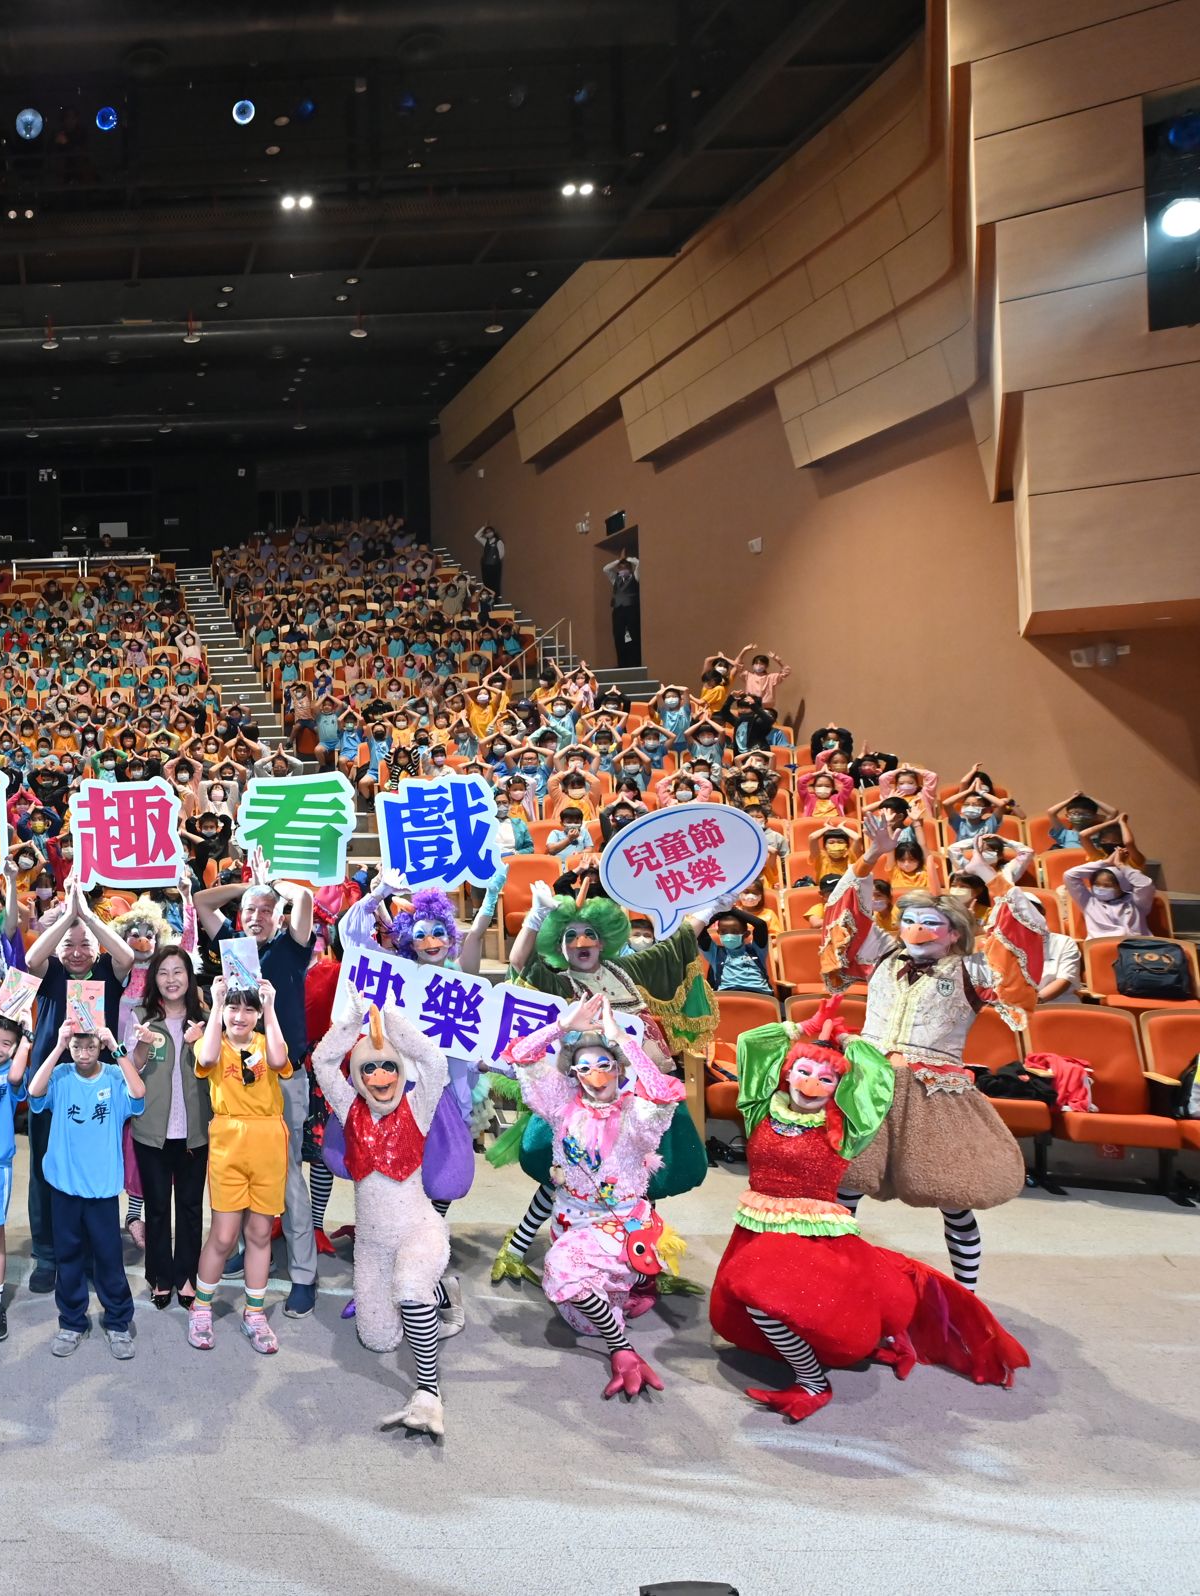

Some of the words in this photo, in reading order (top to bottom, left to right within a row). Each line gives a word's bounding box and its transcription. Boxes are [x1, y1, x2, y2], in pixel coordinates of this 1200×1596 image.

[77, 785, 177, 883] 趣
[244, 778, 348, 876] 看
[383, 781, 497, 886] 戲
[623, 817, 727, 879] 兒童節
[655, 857, 727, 903] 快樂
[67, 1103, 111, 1125] 光華
